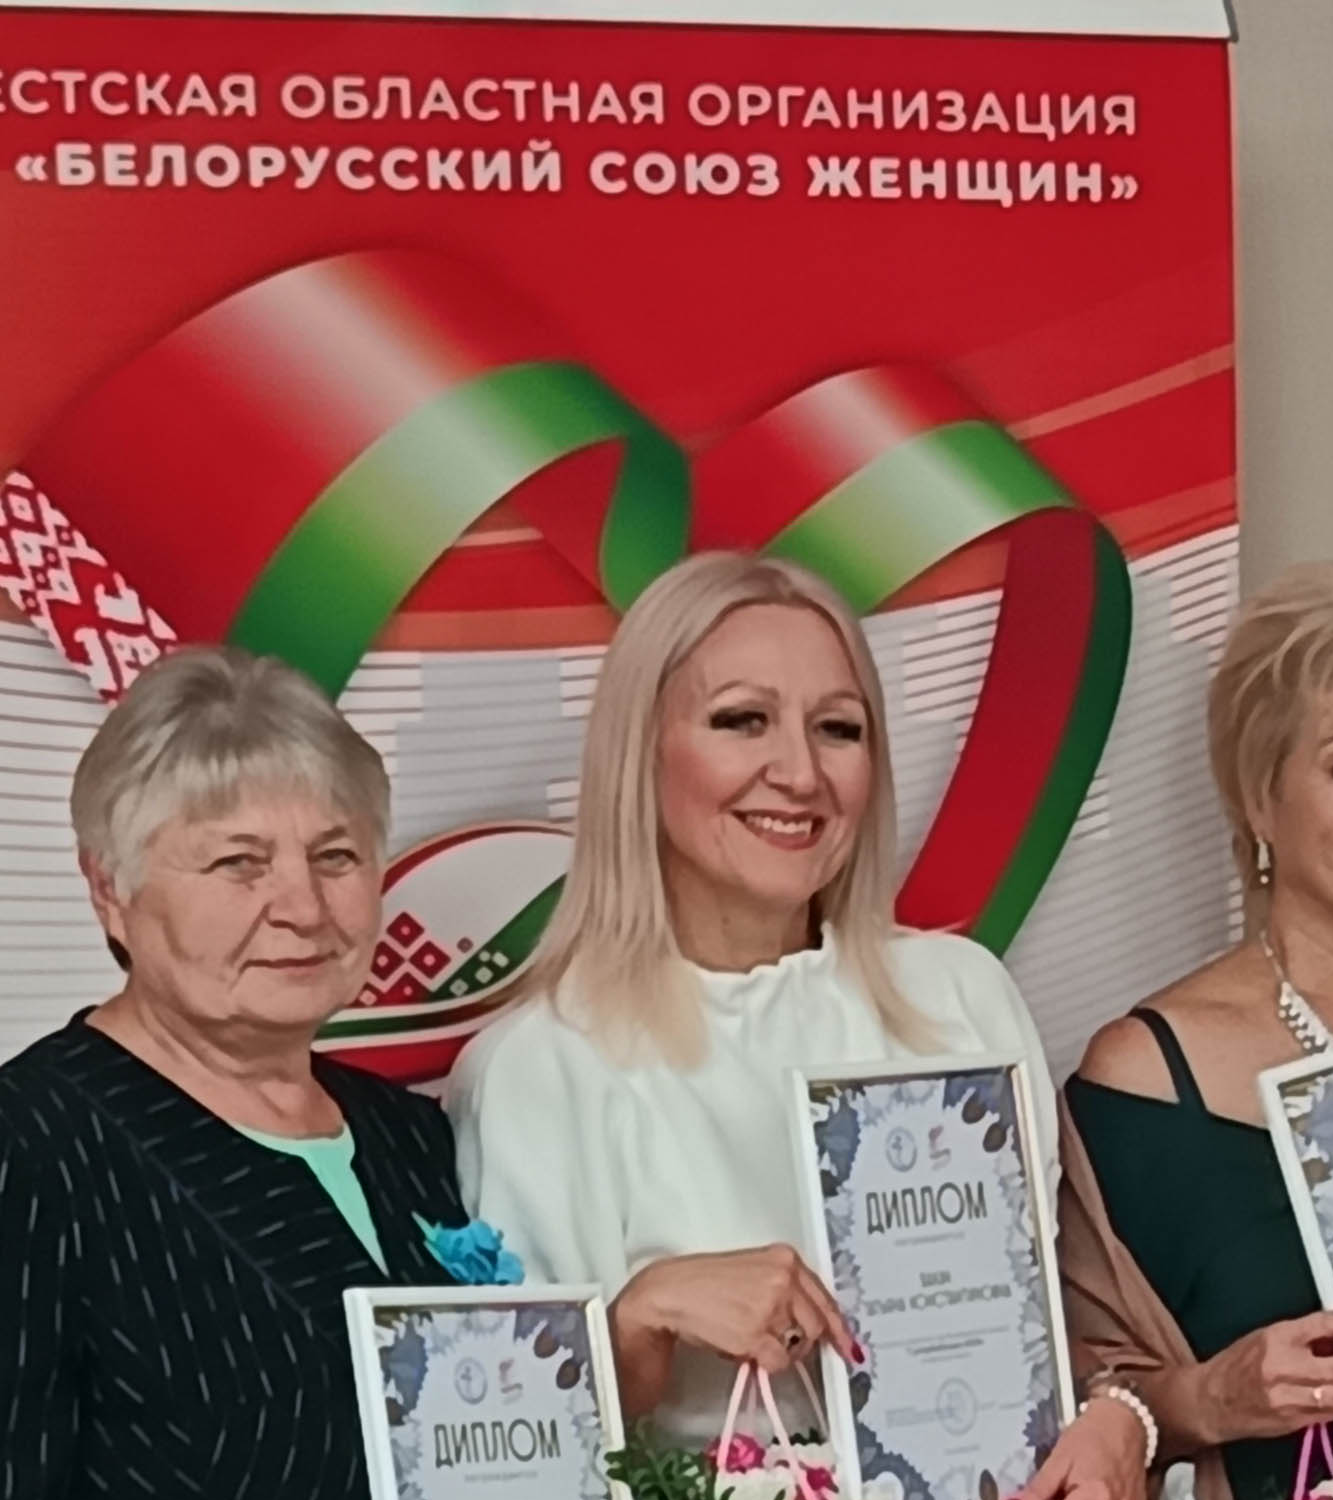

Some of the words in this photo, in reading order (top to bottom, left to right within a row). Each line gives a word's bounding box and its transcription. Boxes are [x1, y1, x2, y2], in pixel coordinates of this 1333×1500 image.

[0, 70, 257, 118] СТСКАЯ
[280, 74, 665, 125] ОБЛАСТНАЯ
[687, 82, 1138, 142] ОРГАНИЗАЦИЯ
[14, 138, 563, 192] «БЕЛОРУССКИЙ
[588, 150, 781, 197] СОЮЗ
[806, 155, 1140, 208] ЖЕНЩИН»
[865, 1180, 988, 1235] ДИПЛОМ
[432, 1416, 562, 1470] ДИПЛОМ
